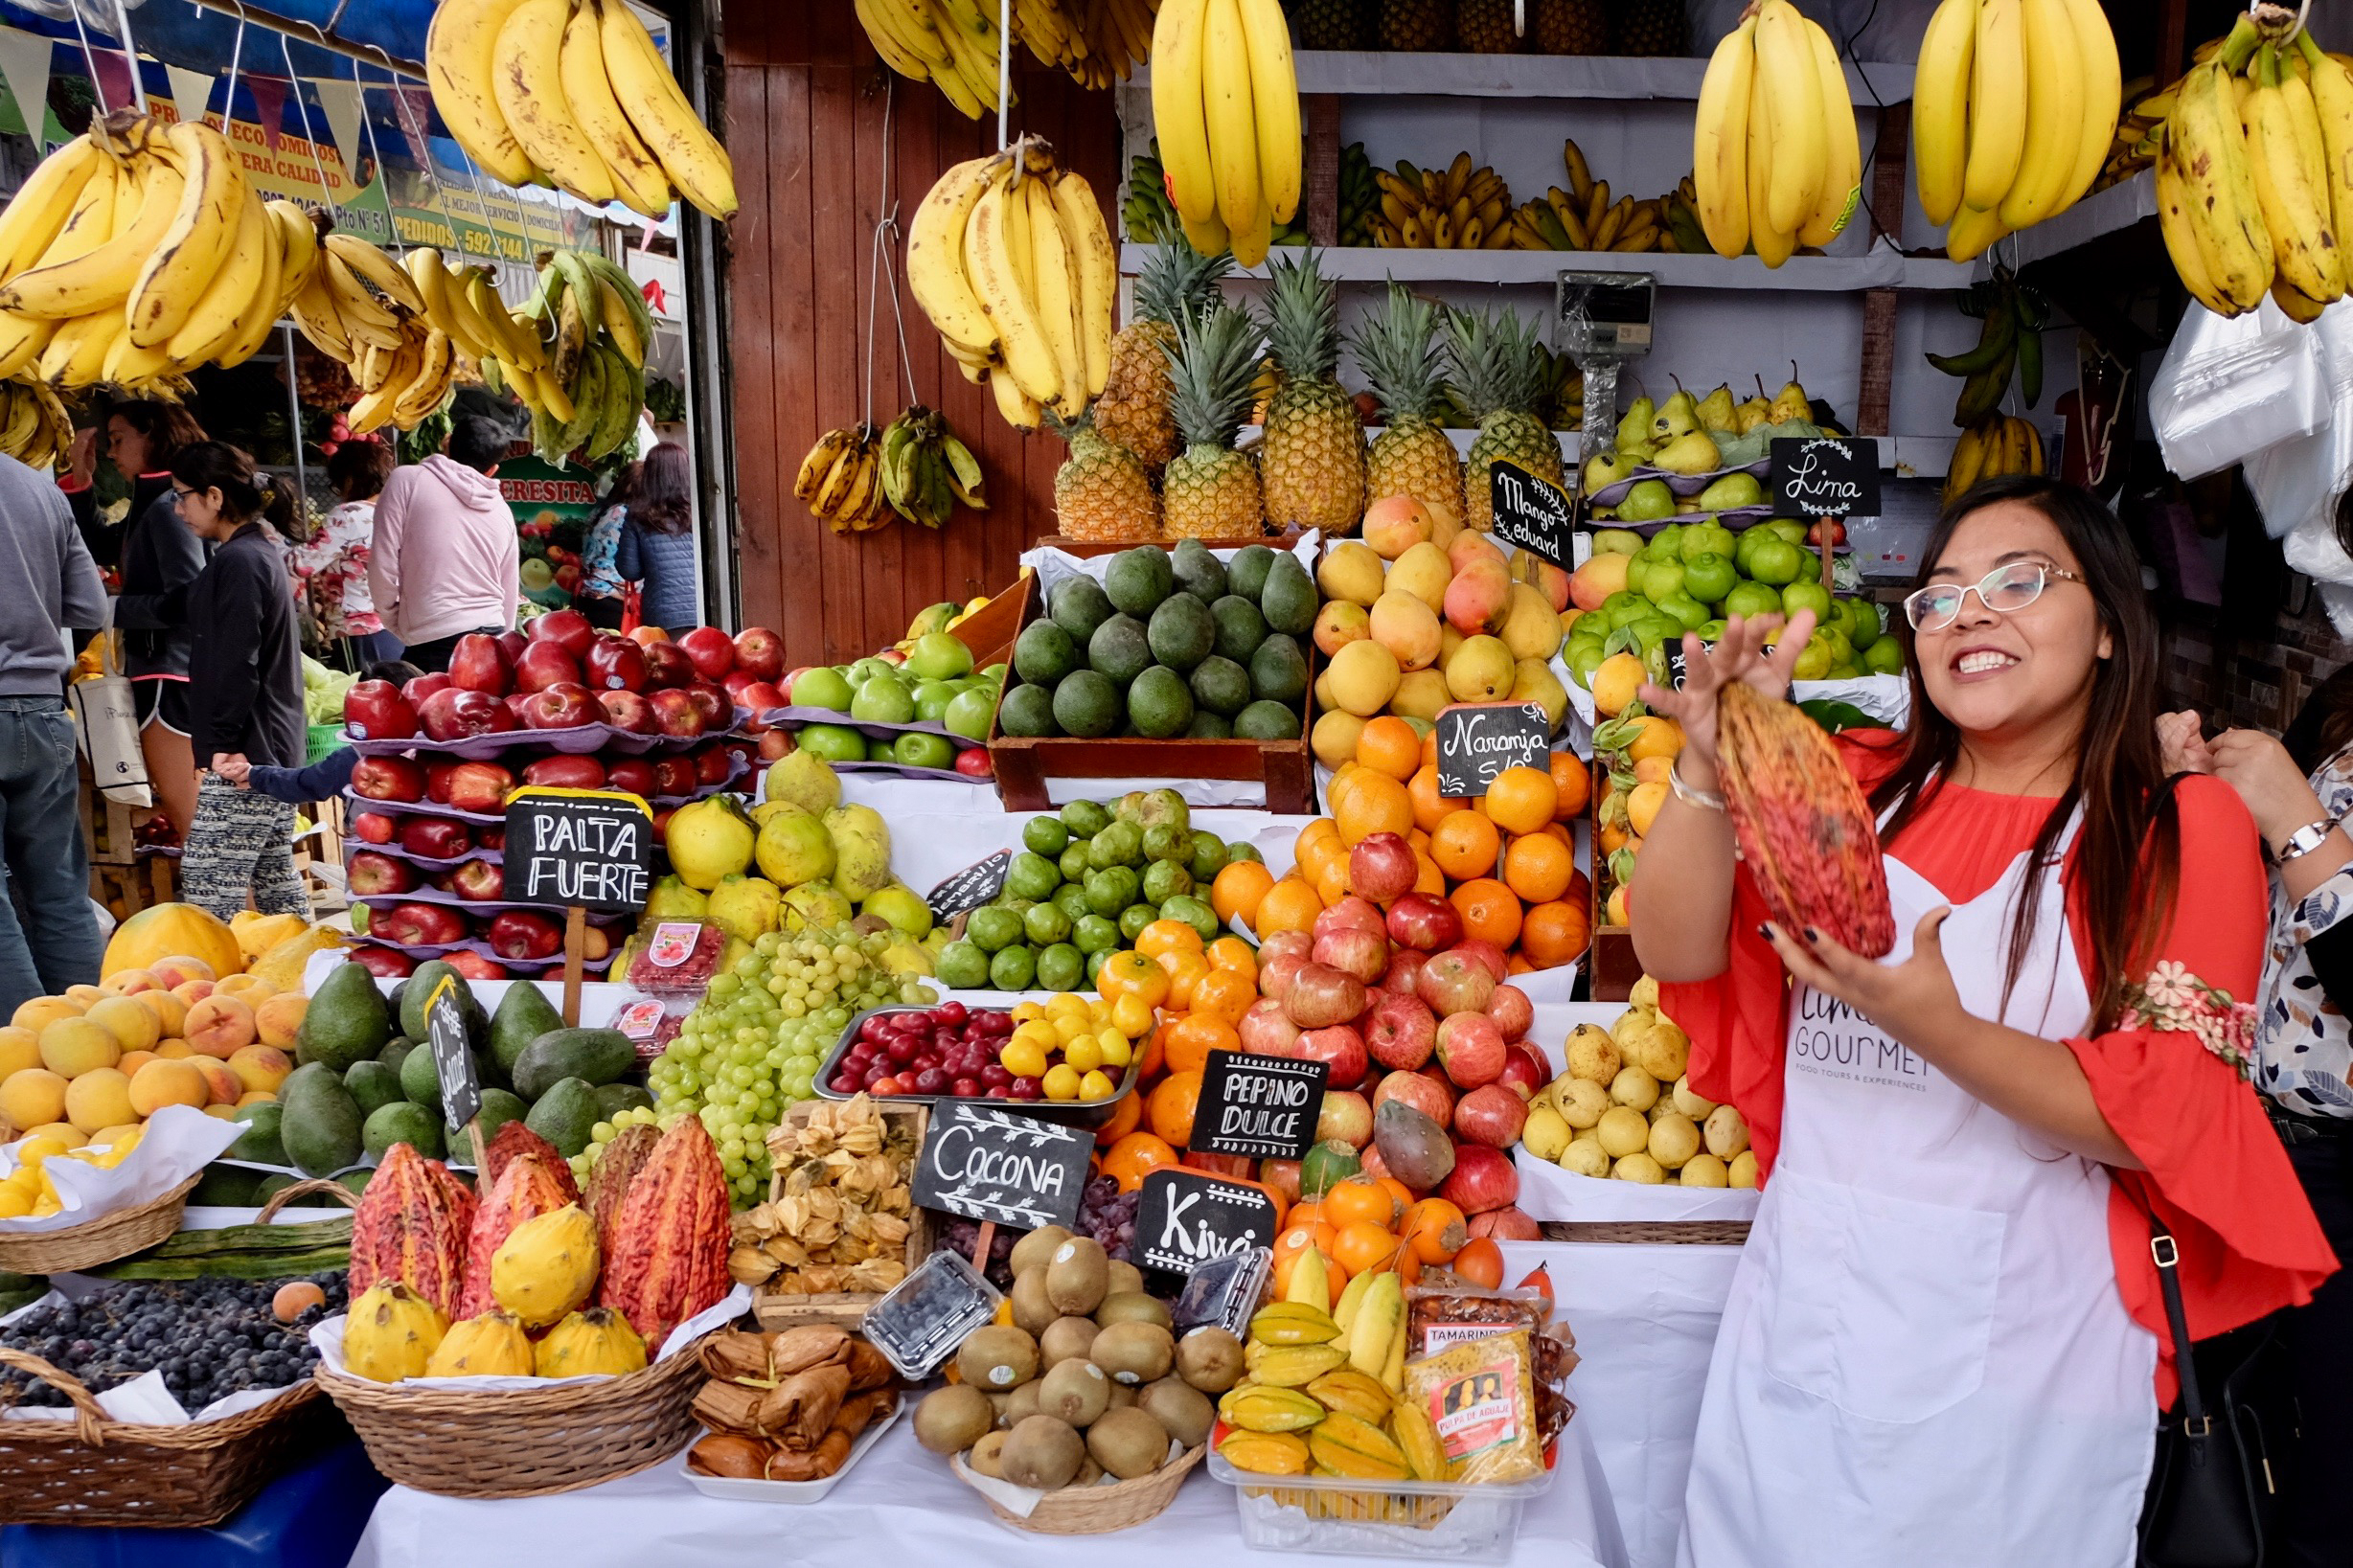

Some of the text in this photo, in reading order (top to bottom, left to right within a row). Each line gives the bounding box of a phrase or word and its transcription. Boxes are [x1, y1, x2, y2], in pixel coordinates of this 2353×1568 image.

[232, 123, 336, 164] ECOOMICOS
[276, 160, 341, 190] CALIDAD
[452, 197, 481, 216] MEJOR
[485, 204, 520, 222] SERVICIO
[465, 229, 491, 254] 592
[499, 479, 597, 504] ERESITA
[1786, 453, 1862, 498] Lima
[1497, 472, 1556, 532] Mango
[1444, 714, 1548, 762] Naranja
[534, 814, 636, 860] PALTA
[528, 856, 649, 904] FUERTE
[1222, 1073, 1309, 1107] PEPINO
[1795, 1062, 1818, 1074] FOOD
[1820, 1069, 1851, 1080] TOURS
[1862, 1076, 1927, 1093] EXPERIENCES
[1220, 1104, 1301, 1139] DULCE
[1159, 1182, 1256, 1260] Kiwi
[1431, 1329, 1502, 1340] TAMARIN
[1439, 1415, 1465, 1432] PULPA
[1479, 1403, 1509, 1418] AGUAJE
